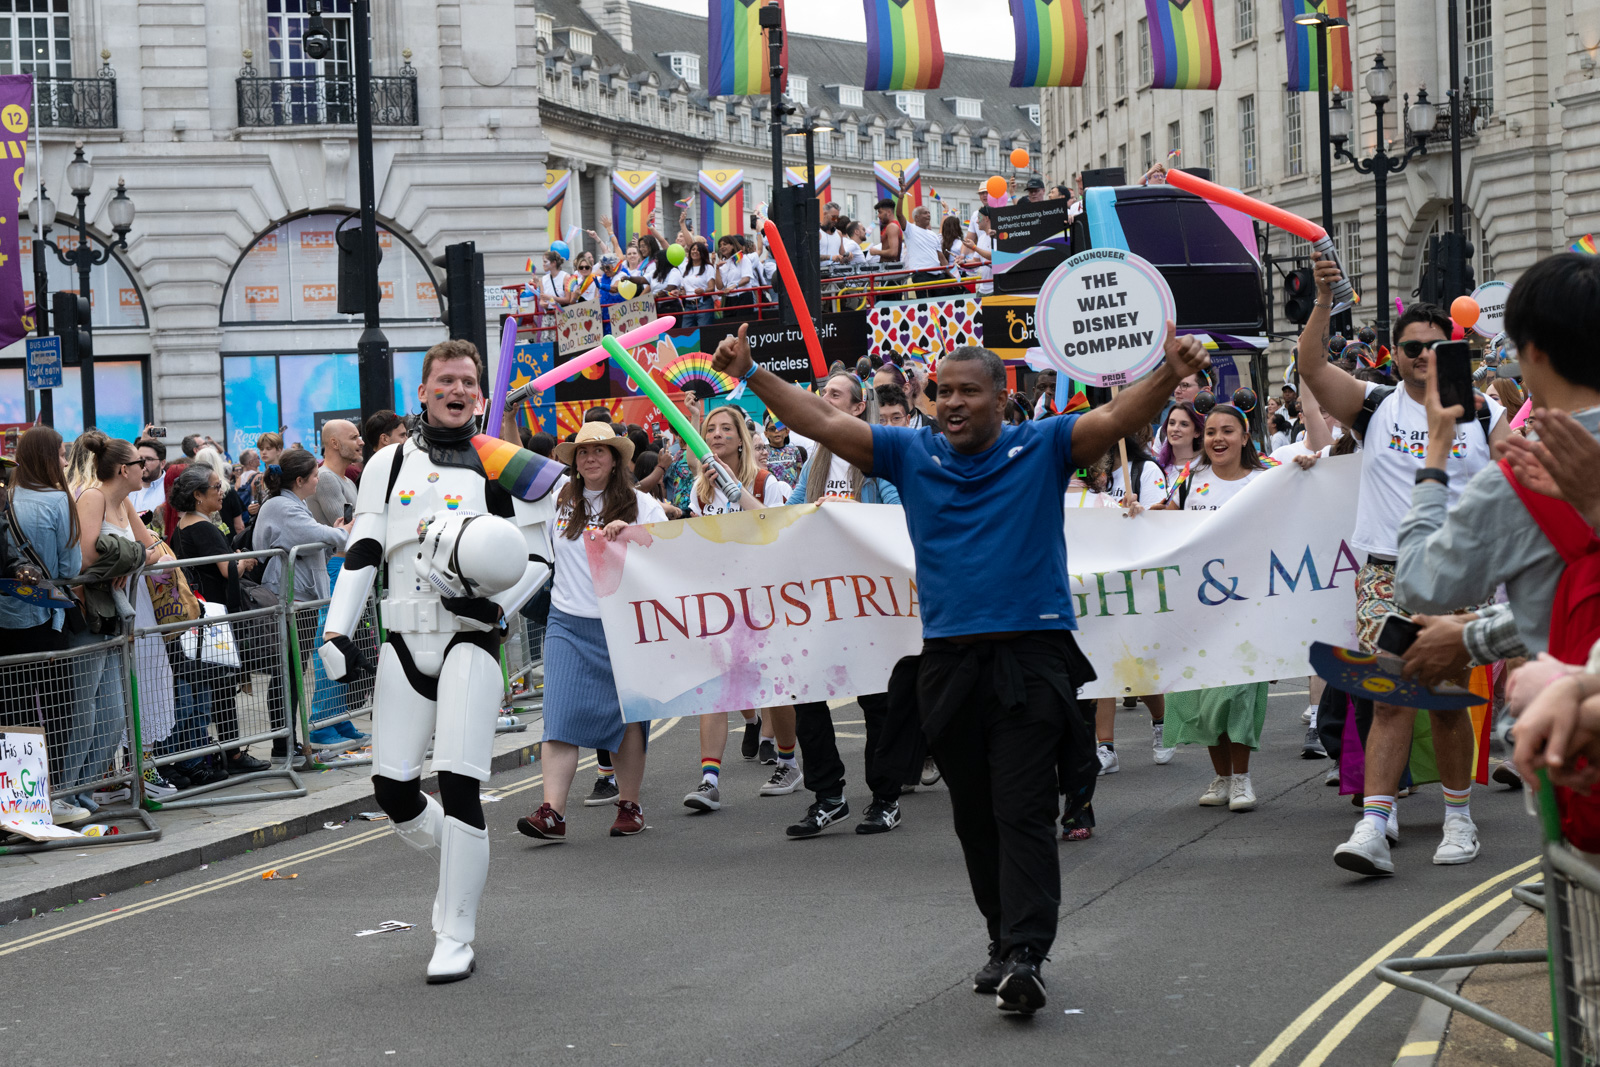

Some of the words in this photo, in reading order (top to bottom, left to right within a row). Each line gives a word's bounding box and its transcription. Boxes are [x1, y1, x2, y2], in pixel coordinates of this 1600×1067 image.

[7, 112, 24, 126] 12
[998, 214, 1011, 222] Being
[1021, 210, 1043, 219] amazing,
[1043, 207, 1064, 216] beautiful,
[1009, 230, 1031, 239] priceless
[1067, 250, 1126, 268] VOLUNQUEER
[1081, 271, 1119, 290] THE
[1077, 291, 1128, 313] WALT
[1480, 303, 1505, 314] ASTERC
[558, 309, 575, 331] PROUD
[610, 304, 628, 327] PROUD
[629, 301, 655, 313] LESBIAN
[1487, 311, 1504, 320] PRID
[571, 322, 578, 332] TO
[627, 318, 634, 328] TO
[1072, 311, 1139, 335] DISNEY
[30, 340, 41, 349] BUS
[42, 339, 57, 348] LANE
[560, 339, 575, 353] LOUD
[577, 333, 601, 347] LESBIAN
[759, 332, 784, 347] your
[786, 328, 804, 341] tru
[1064, 330, 1154, 358] COMPANY
[759, 356, 809, 372] priceless
[827, 479, 847, 489] are
[628, 574, 919, 645] INDUSTRIA
[1068, 564, 1182, 619] GHT
[1197, 558, 1250, 606] &
